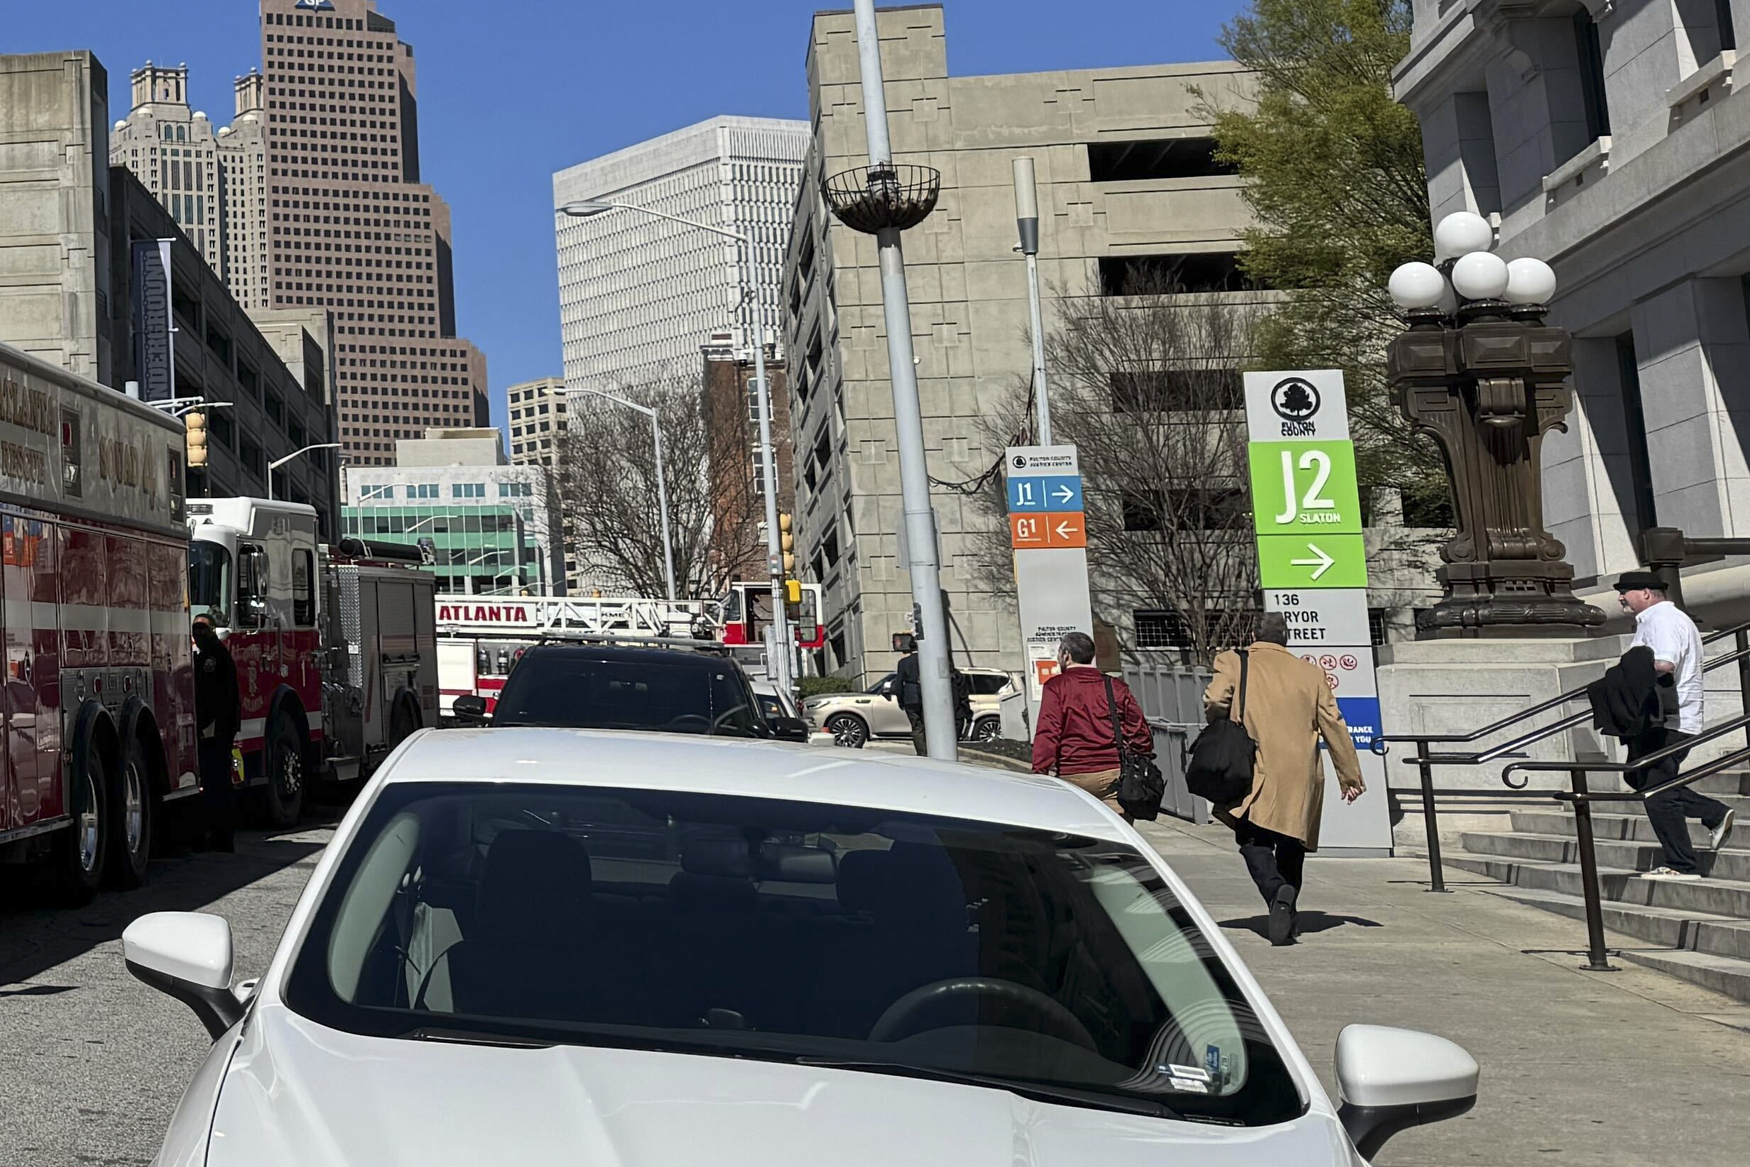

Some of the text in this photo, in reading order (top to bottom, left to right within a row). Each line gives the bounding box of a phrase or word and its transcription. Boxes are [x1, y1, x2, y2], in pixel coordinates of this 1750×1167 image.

[145, 249, 169, 401] NDERGROUND
[1281, 421, 1315, 430] FULTON
[1281, 428, 1317, 437] COUNTY
[0, 440, 46, 485] RESCUE
[98, 434, 156, 511] SQUAD 4
[1016, 482, 1033, 506] J1
[1275, 449, 1335, 525] J2
[1299, 512, 1341, 525] SLATON
[1017, 518, 1037, 538] G1
[1274, 594, 1300, 606] 136
[438, 605, 528, 622] ATLANTA
[1283, 610, 1319, 623] RYOR
[1286, 627, 1327, 640] TREET
[1355, 735, 1372, 744] YOU
